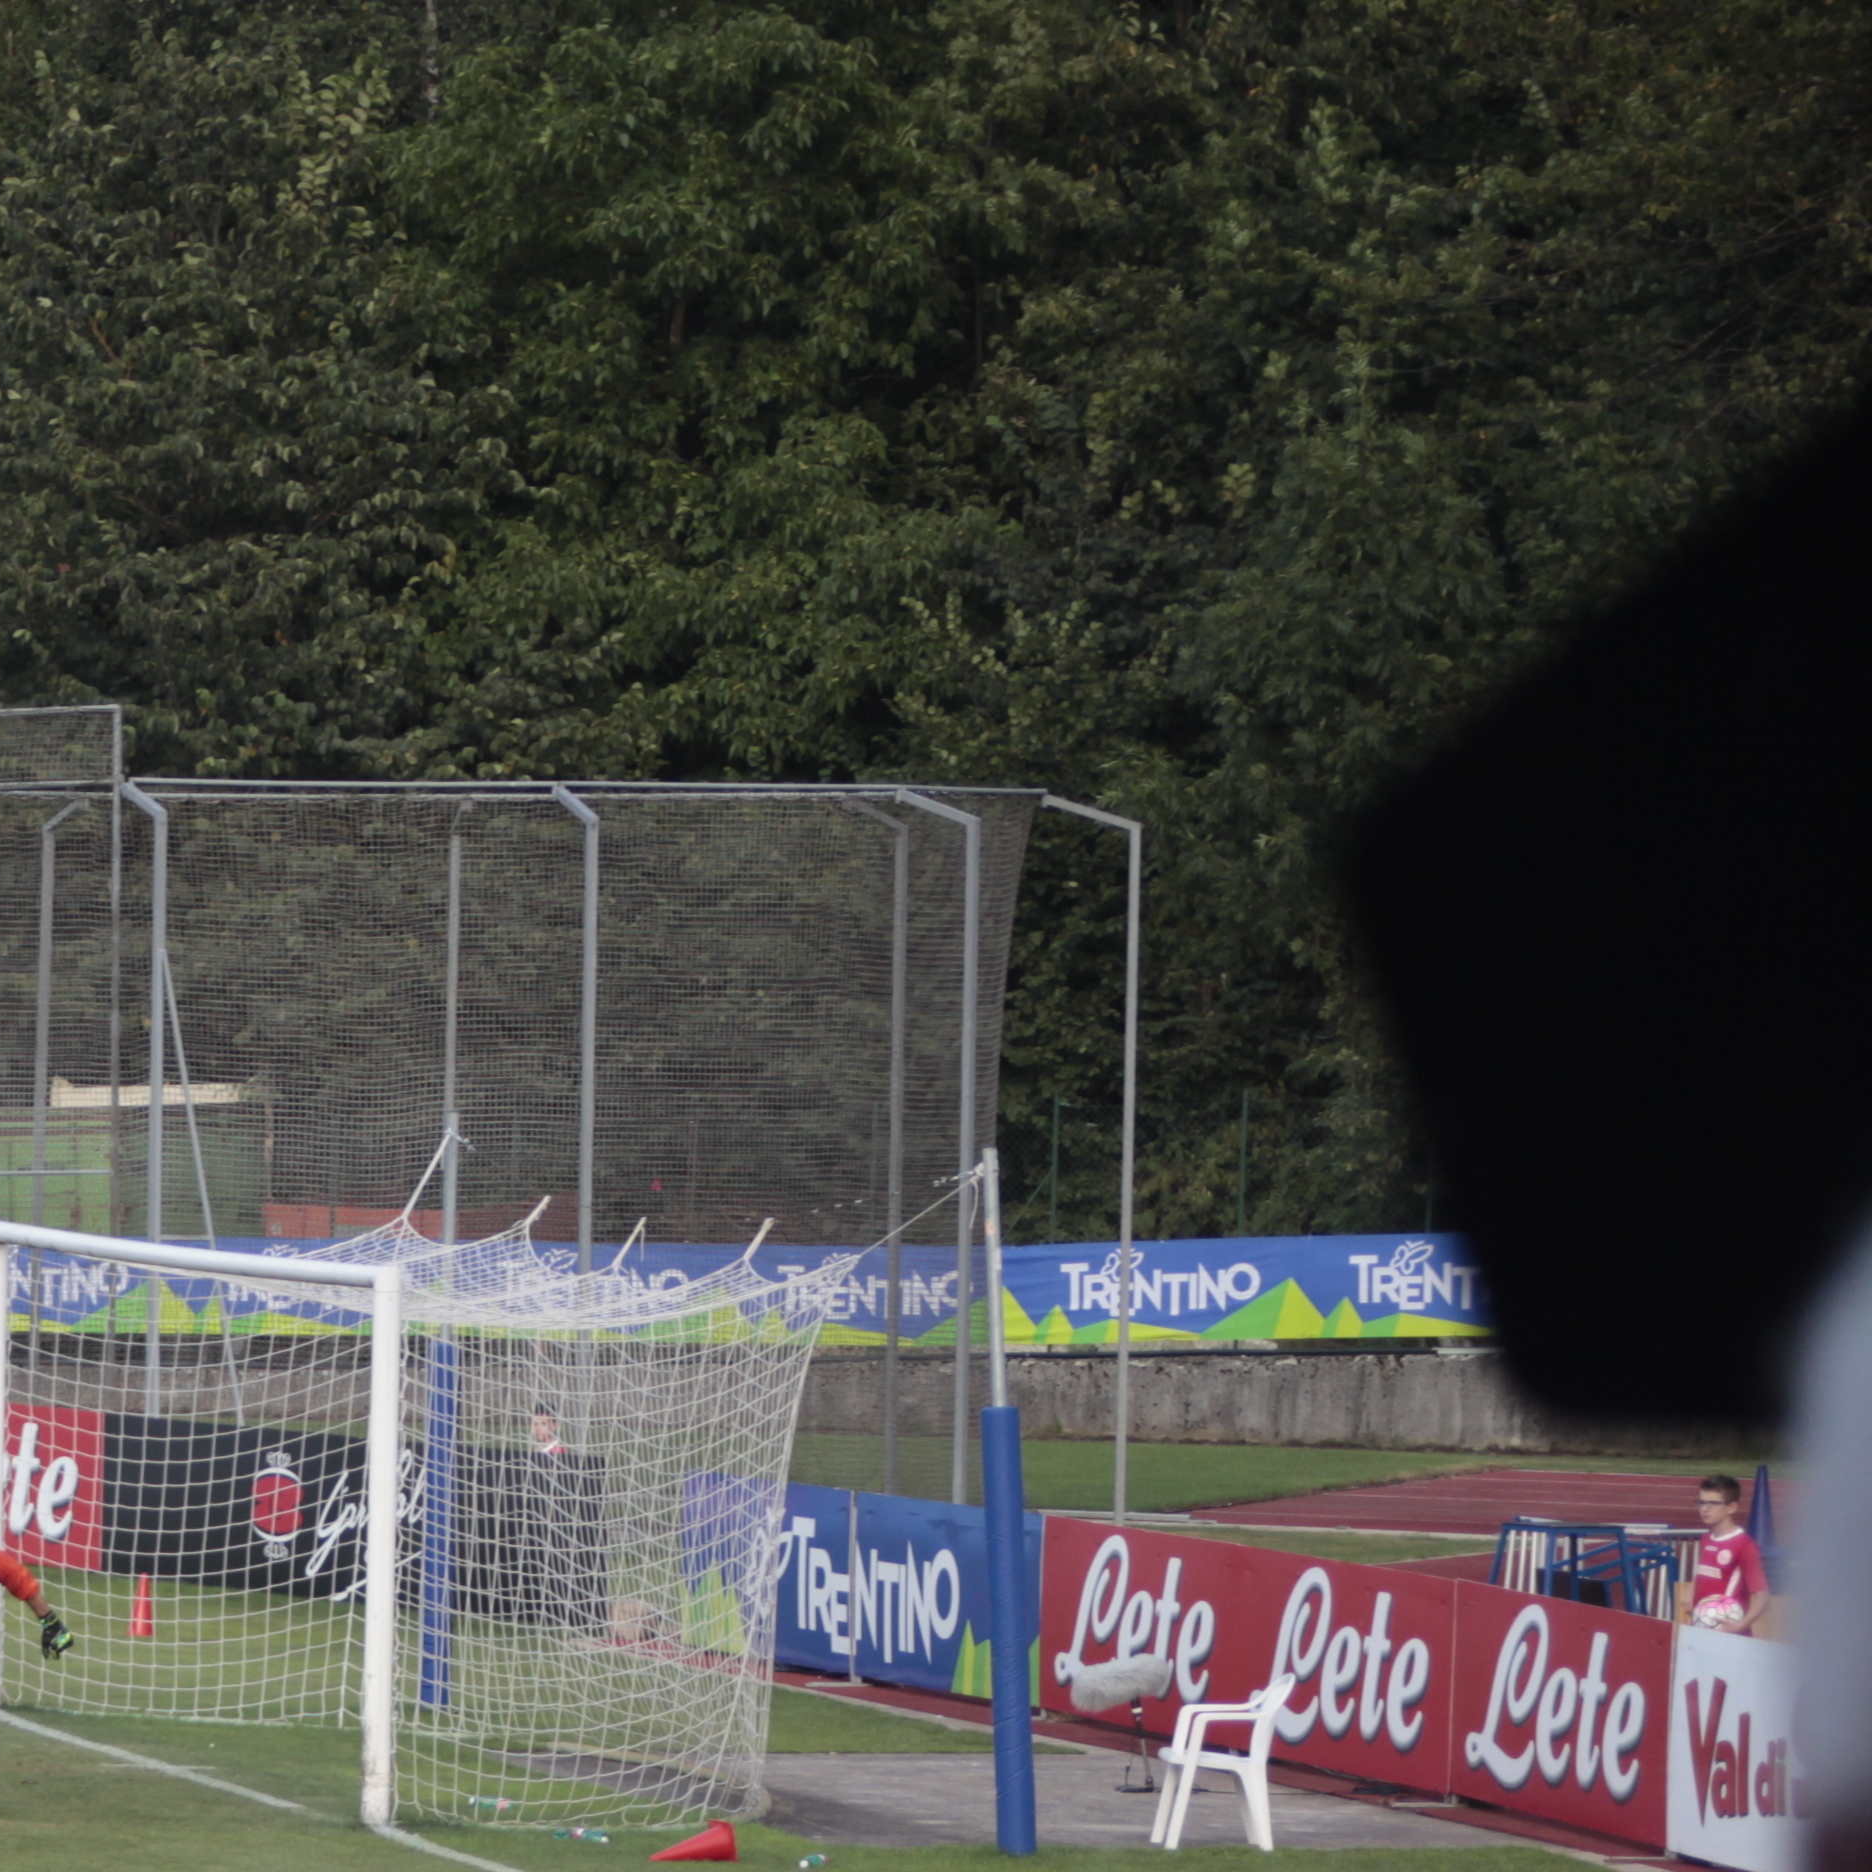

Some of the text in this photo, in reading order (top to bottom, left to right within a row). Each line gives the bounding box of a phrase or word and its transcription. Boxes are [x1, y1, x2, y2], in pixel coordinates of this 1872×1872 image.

[1059, 1262, 1260, 1317] TRENTINO
[792, 1516, 960, 1665] TRENTINO
[1248, 1566, 1431, 1756] Lete
[1465, 1603, 1647, 1800] Lete
[1684, 1675, 1752, 1829] Val
